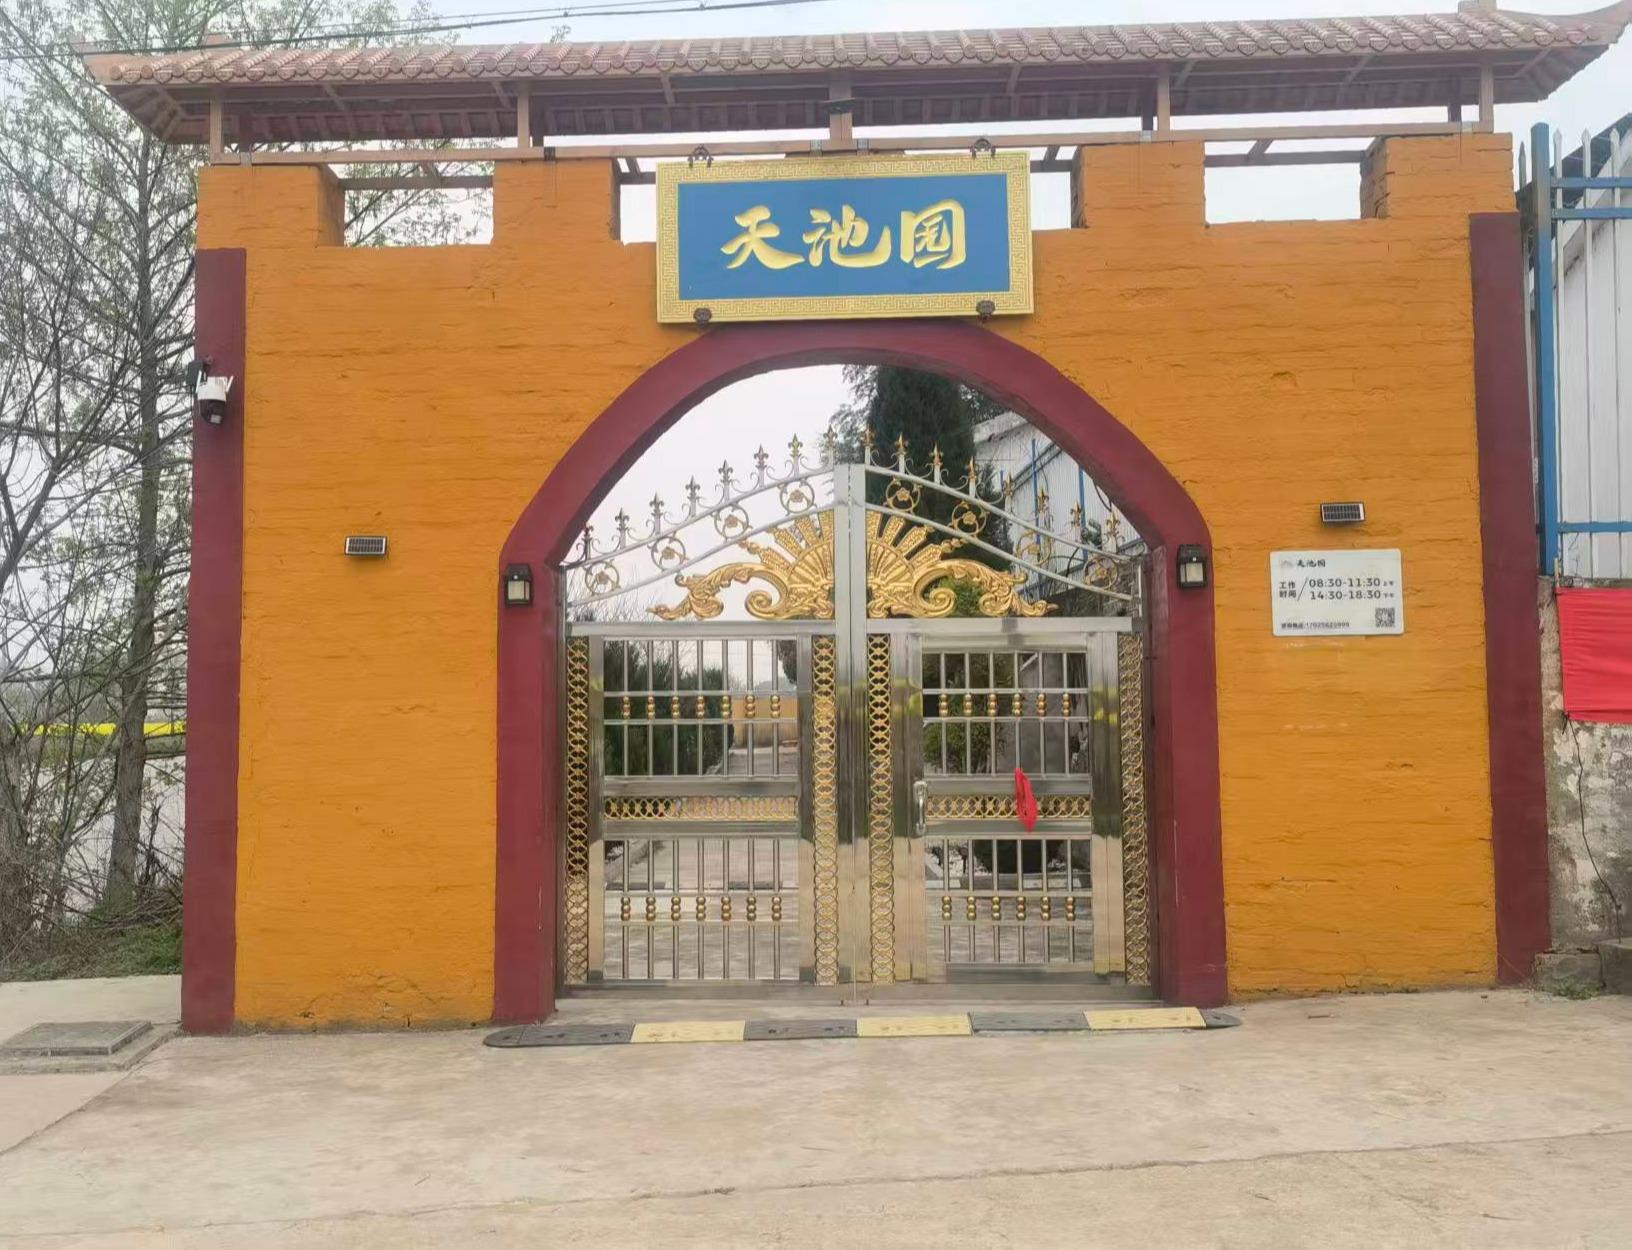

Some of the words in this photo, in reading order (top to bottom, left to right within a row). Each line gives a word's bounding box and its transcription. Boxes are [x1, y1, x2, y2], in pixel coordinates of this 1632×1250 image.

[720, 198, 967, 270] 天池园
[1279, 581, 1296, 589] 工作
[1308, 577, 1381, 588] 08:30-11:30
[1279, 590, 1297, 598] 时间
[1310, 589, 1381, 600] 14:30-18:30
